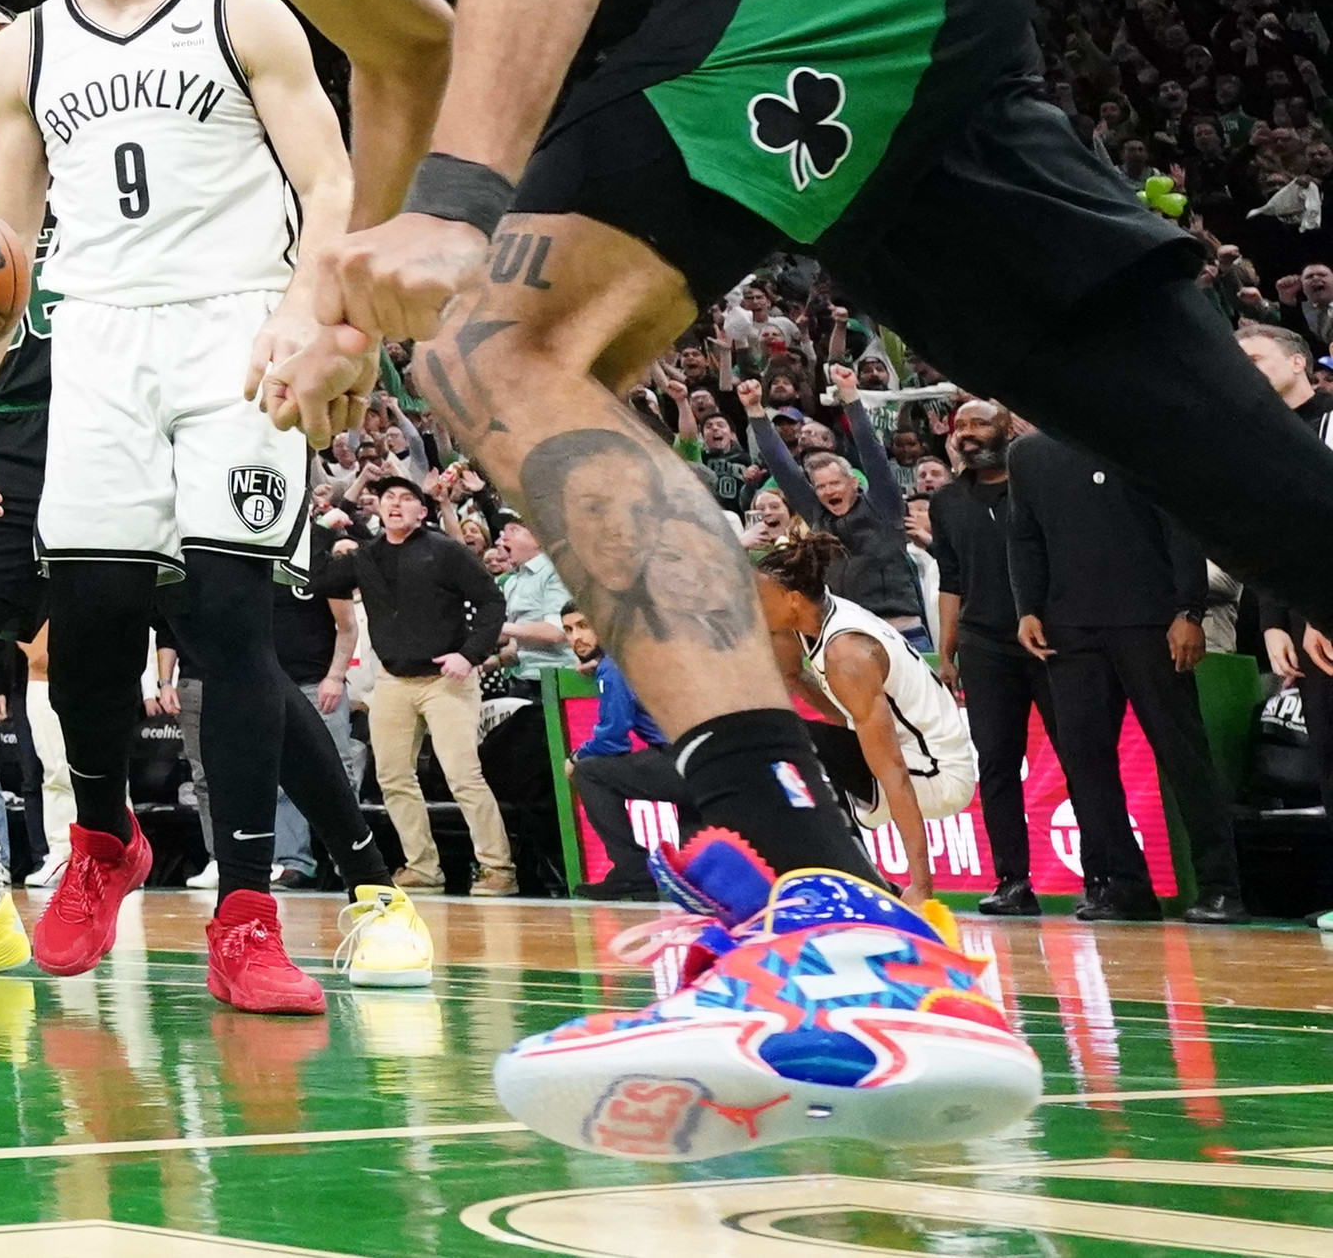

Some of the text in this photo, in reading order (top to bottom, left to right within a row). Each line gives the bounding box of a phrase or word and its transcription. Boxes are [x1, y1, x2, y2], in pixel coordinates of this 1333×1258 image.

[45, 68, 226, 145] BROOKLYN
[114, 141, 150, 220] 9
[232, 470, 286, 502] NETS
[253, 499, 266, 522] B
[140, 725, 184, 740] @celtic
